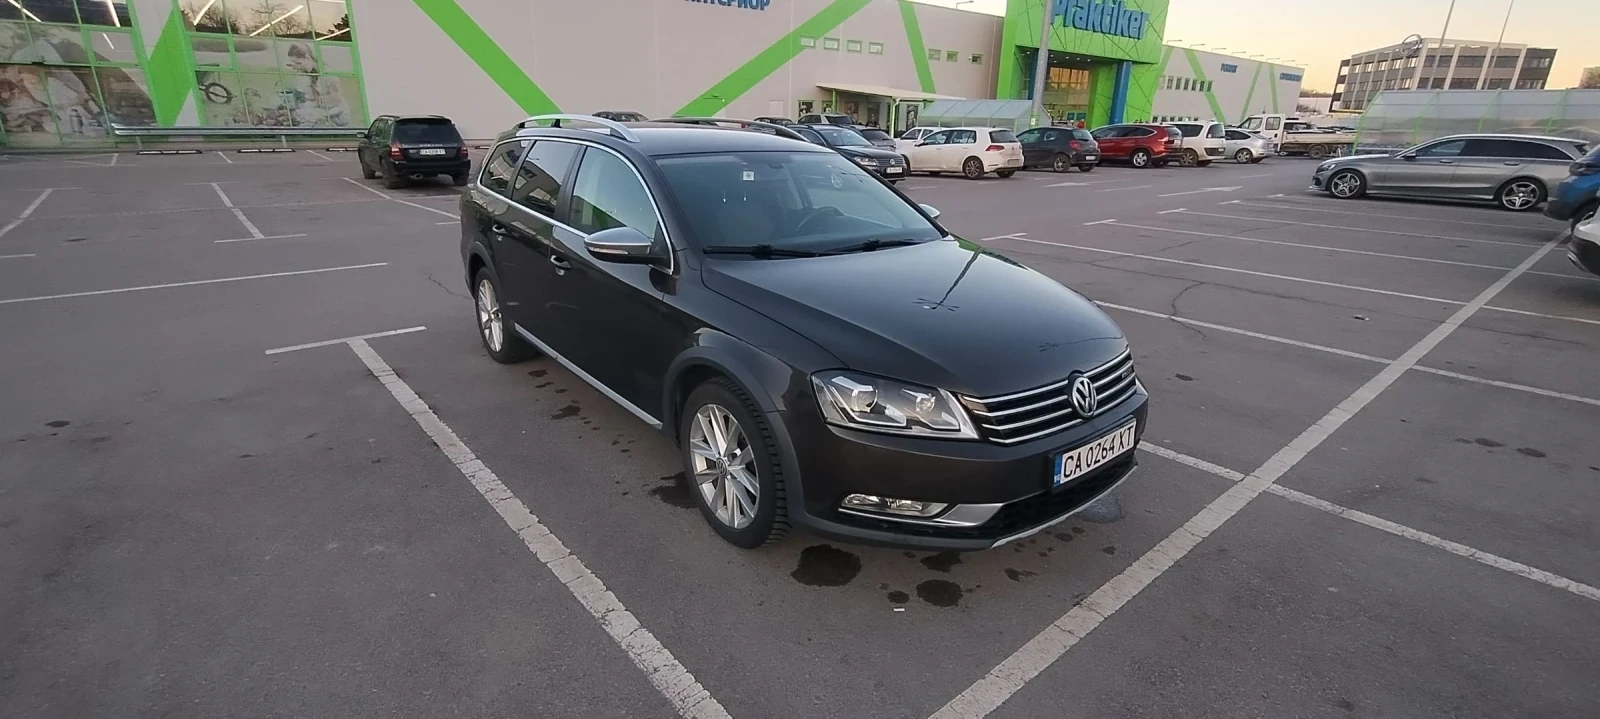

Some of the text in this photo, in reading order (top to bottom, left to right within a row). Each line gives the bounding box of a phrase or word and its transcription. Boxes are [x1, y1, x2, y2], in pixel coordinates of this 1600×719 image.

[1063, 452, 1082, 478] CA
[1086, 434, 1116, 468] 0264
[1118, 425, 1134, 452] XT
